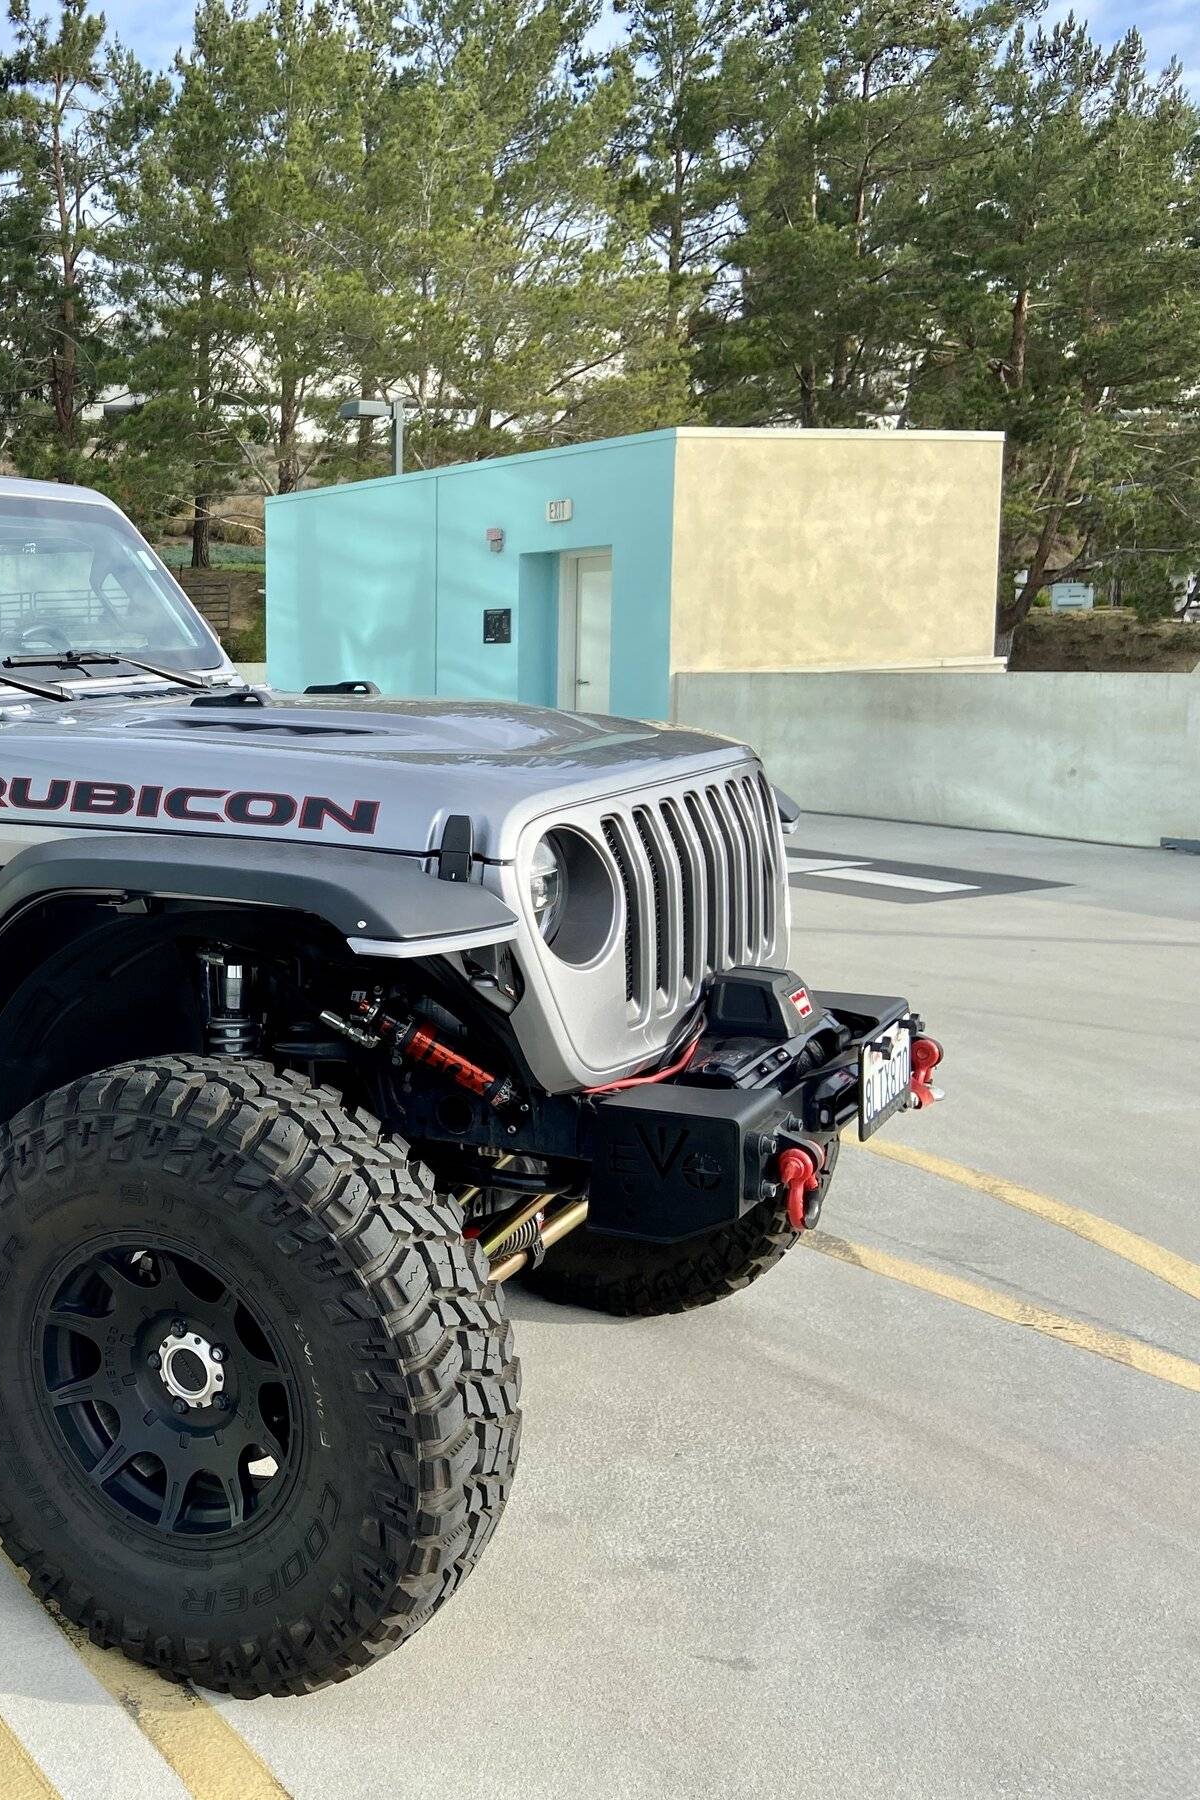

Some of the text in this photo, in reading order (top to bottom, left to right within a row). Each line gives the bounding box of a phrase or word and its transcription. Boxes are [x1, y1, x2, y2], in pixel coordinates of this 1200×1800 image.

[549, 500, 566, 519] EXIT
[865, 1046, 908, 1120] 8LTX870
[180, 1482, 341, 1617] COOPER
